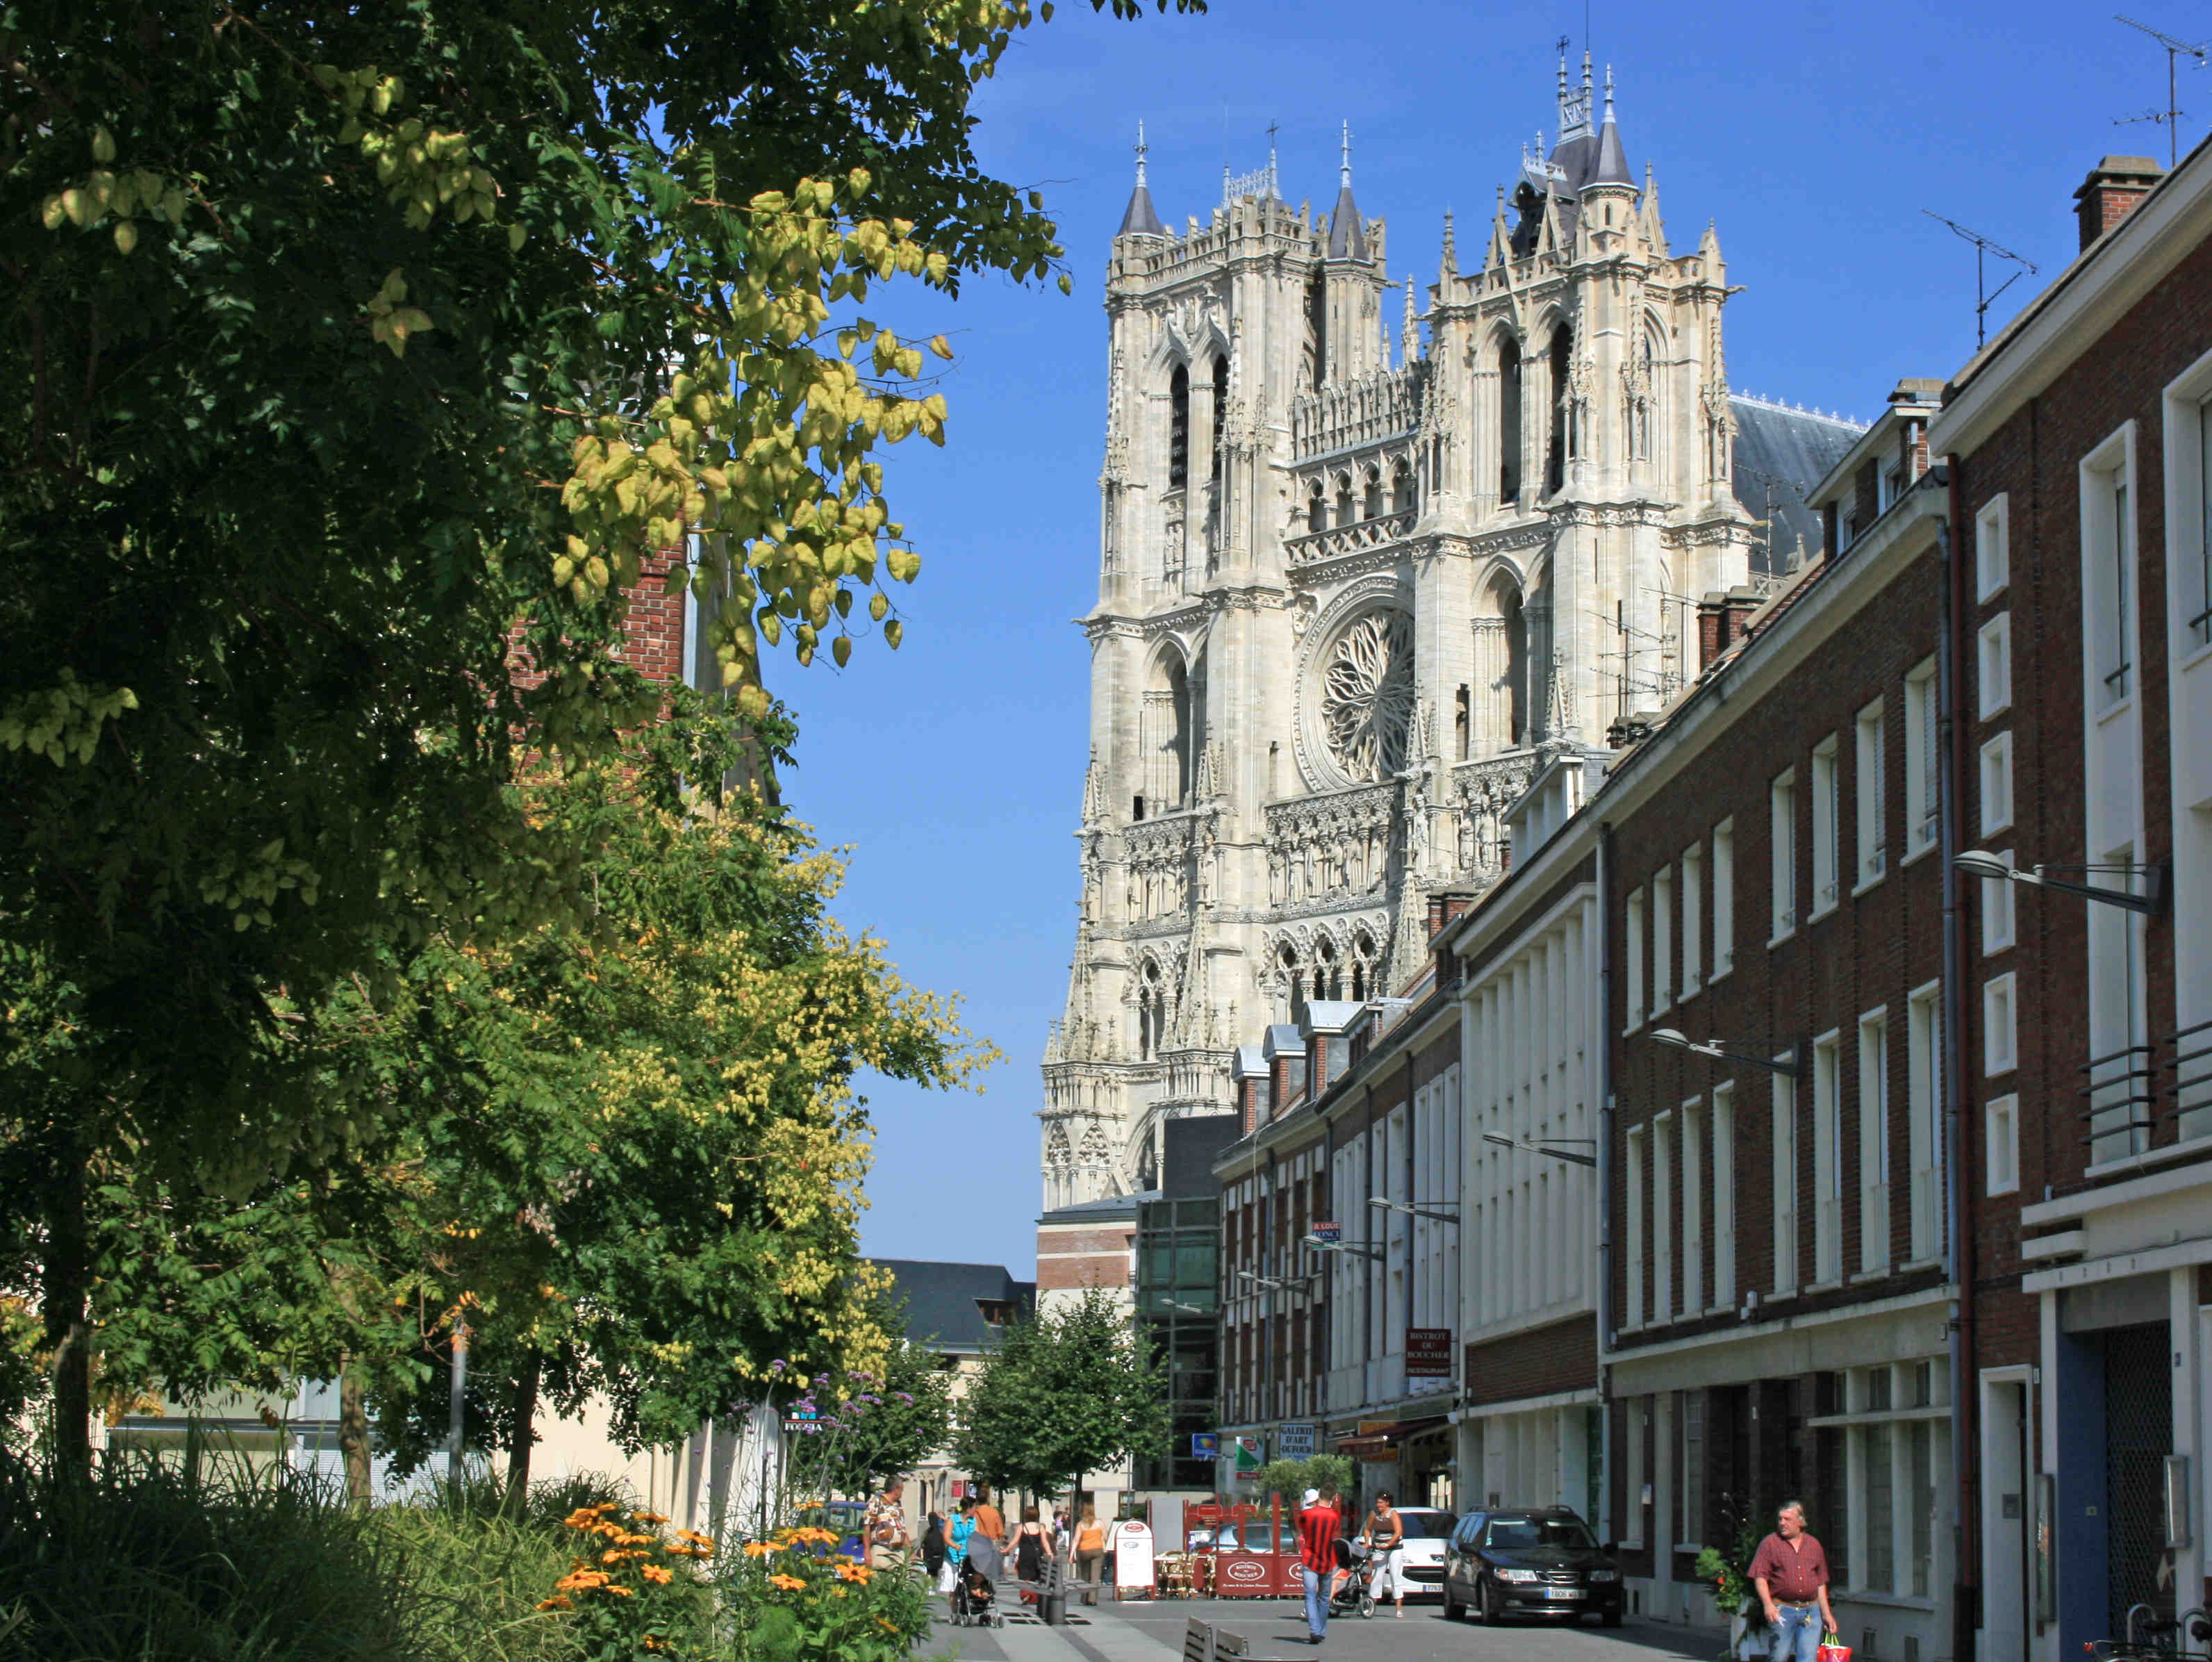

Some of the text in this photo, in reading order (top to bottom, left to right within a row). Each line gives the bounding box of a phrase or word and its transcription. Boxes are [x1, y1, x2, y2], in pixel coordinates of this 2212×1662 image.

[1410, 1332, 1446, 1340] BISTROT
[1407, 1351, 1450, 1359] BOUCHER
[1285, 1435, 1307, 1444] D'ART
